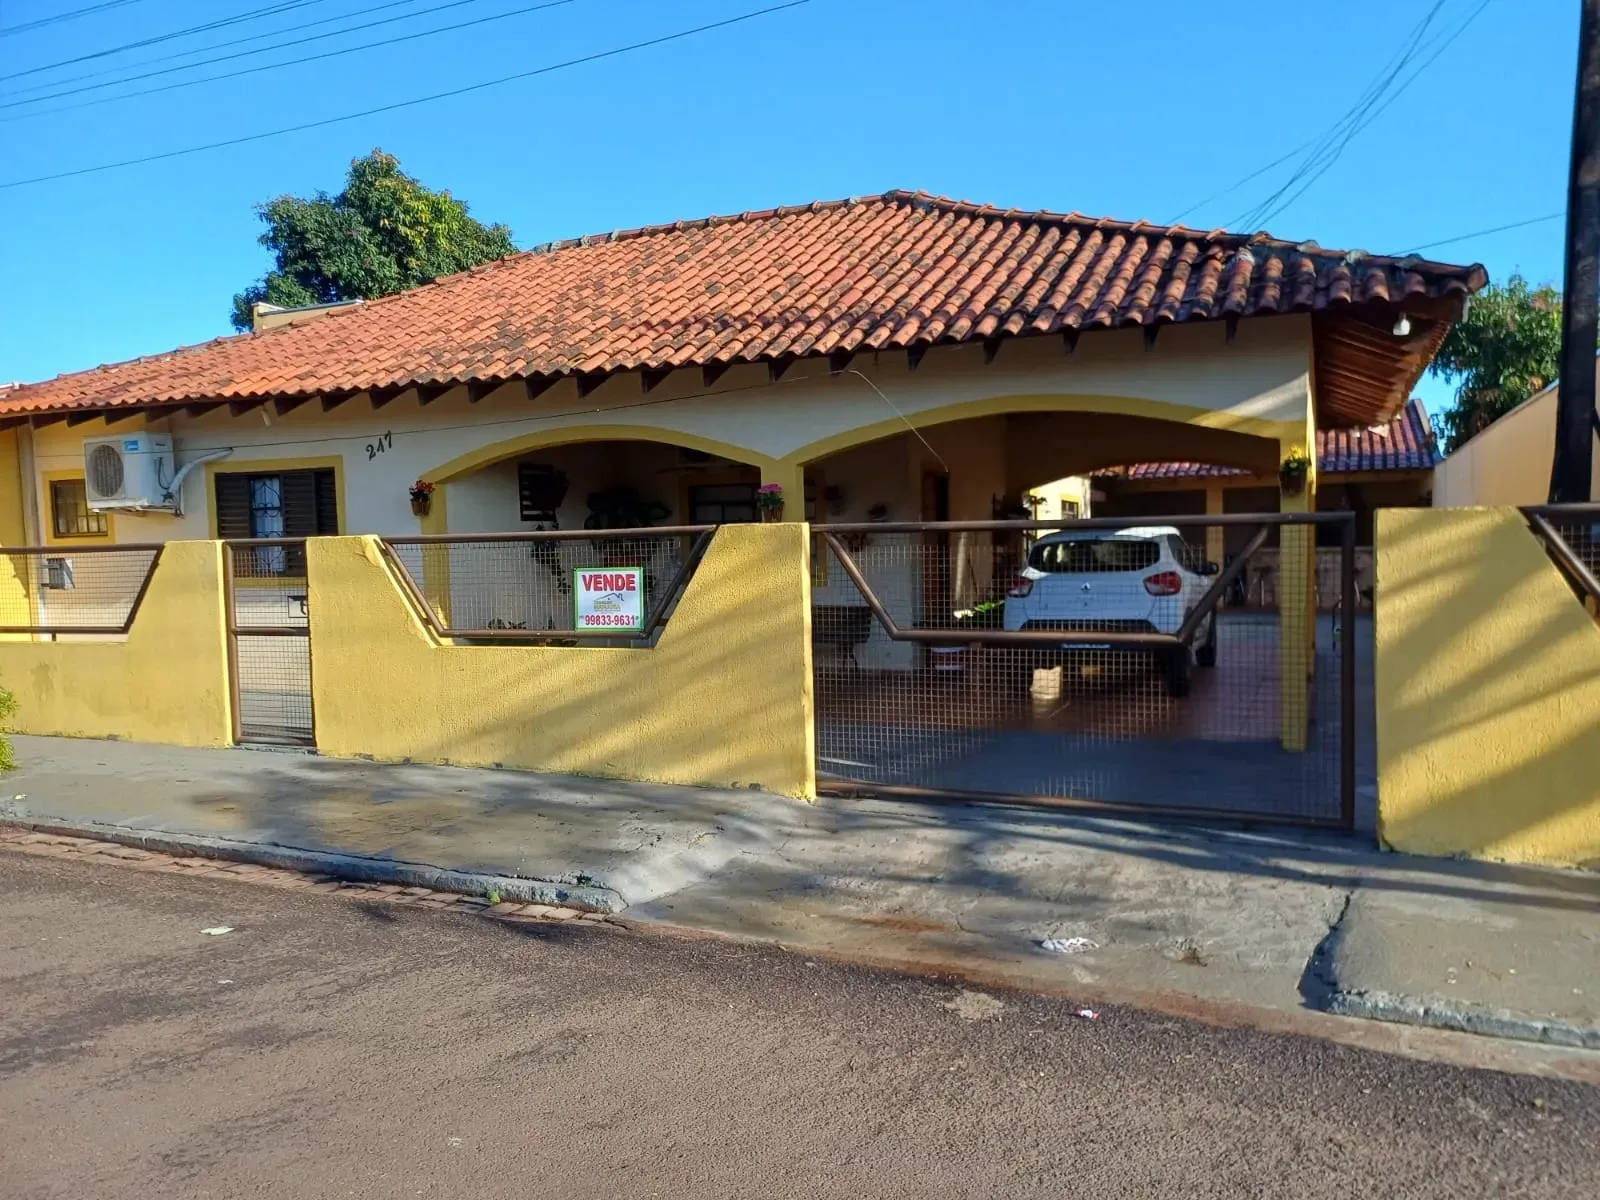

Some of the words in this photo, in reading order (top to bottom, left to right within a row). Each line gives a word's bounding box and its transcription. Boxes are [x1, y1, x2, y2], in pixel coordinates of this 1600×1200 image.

[365, 430, 392, 461] 217
[582, 574, 636, 591] VENDE
[585, 615, 635, 626] 99833-9631
